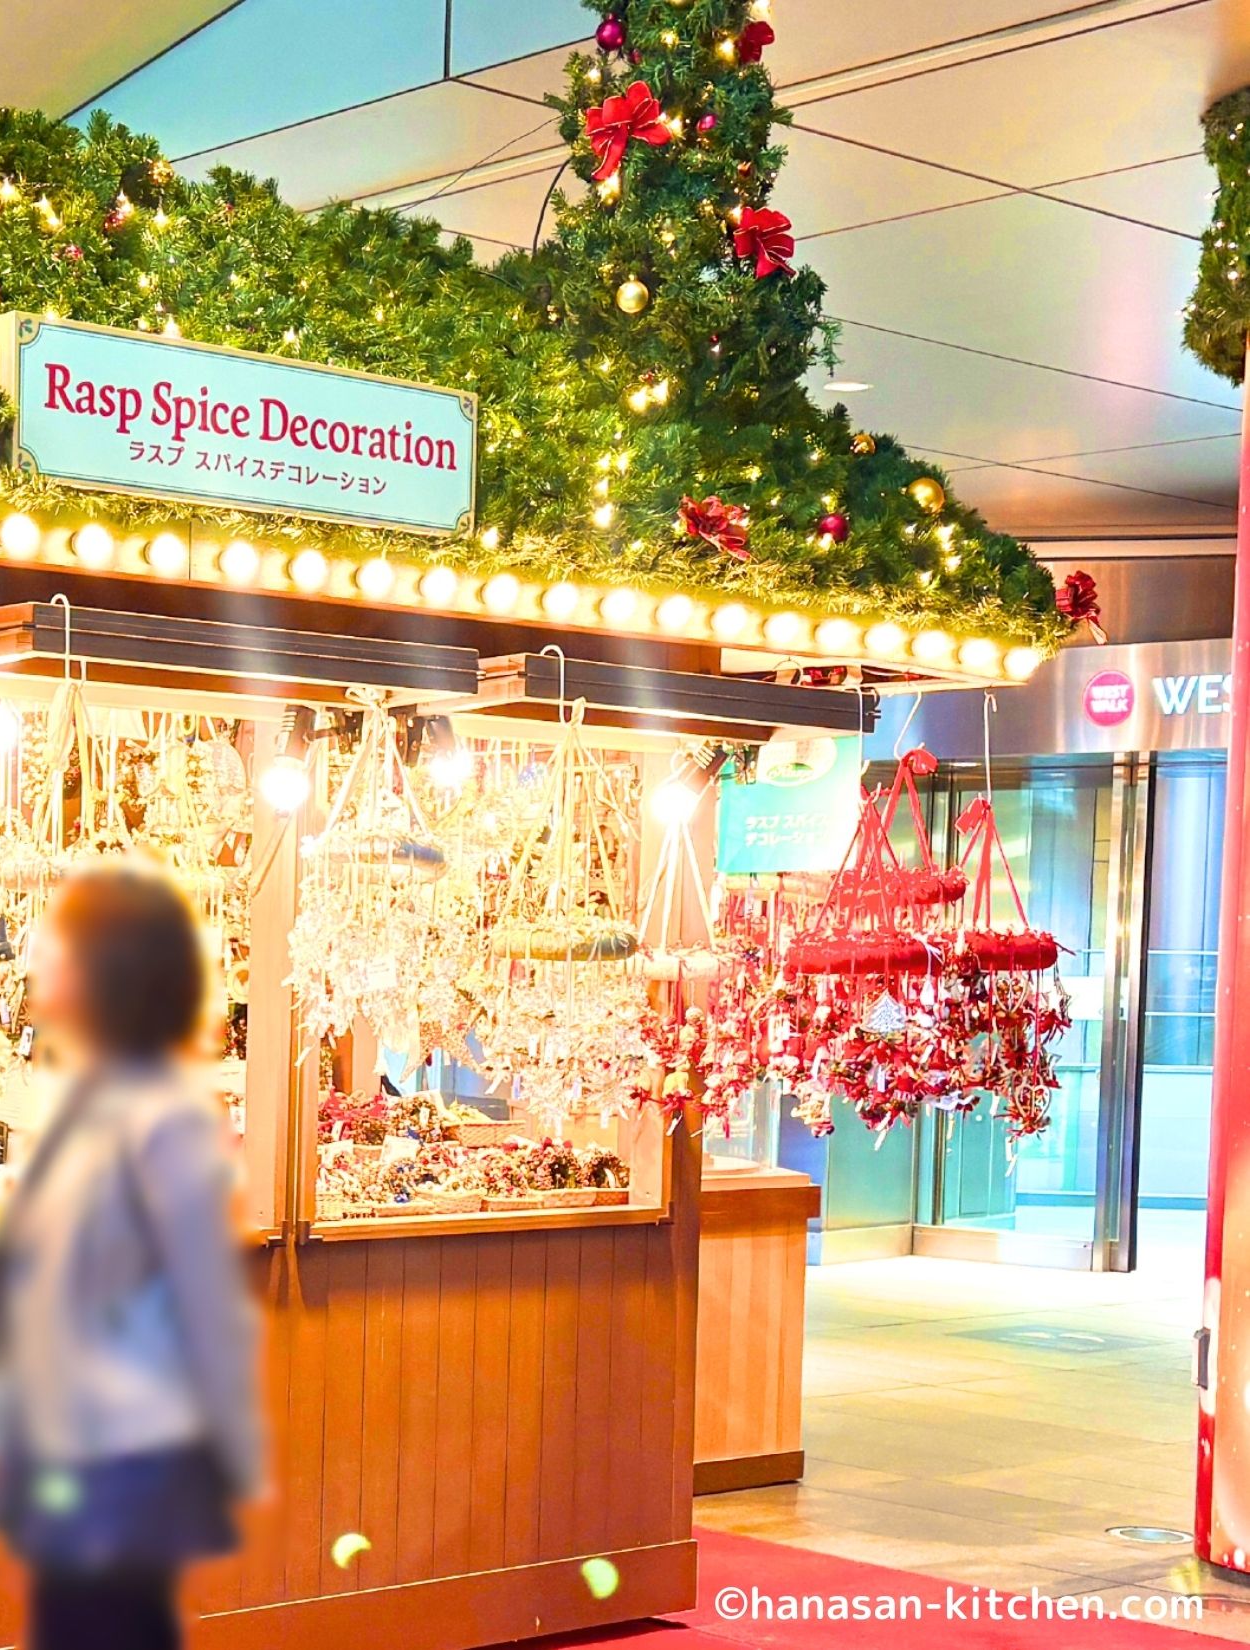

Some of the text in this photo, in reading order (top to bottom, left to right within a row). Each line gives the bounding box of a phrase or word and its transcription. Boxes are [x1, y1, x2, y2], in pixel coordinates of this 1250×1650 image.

[44, 362, 458, 471] Rasp Spice Decoration
[129, 440, 387, 495] ラスプ スパイスデコレーション
[1090, 698, 1129, 714] WALK
[1091, 684, 1130, 699] WEST
